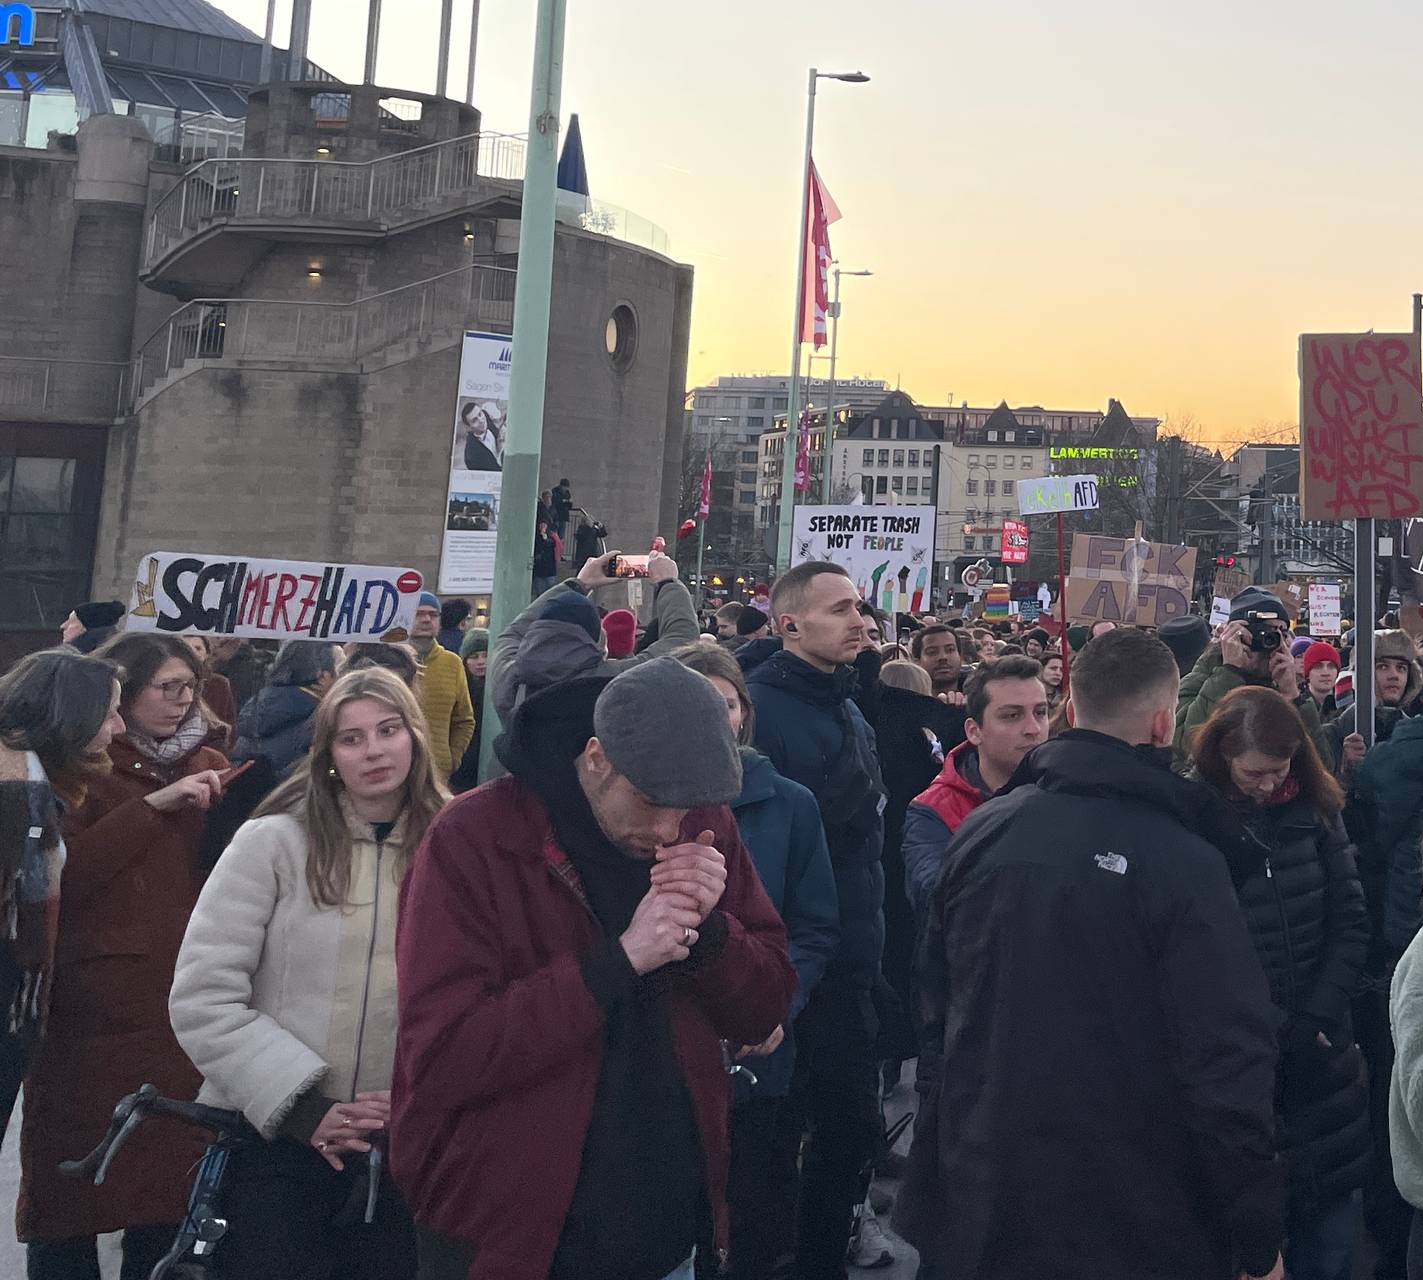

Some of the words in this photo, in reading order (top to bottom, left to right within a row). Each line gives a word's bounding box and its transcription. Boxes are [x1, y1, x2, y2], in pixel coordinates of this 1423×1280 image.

[1325, 480, 1421, 517] AFD
[808, 515, 878, 532] SEPARATE
[882, 516, 920, 534] TRASH
[827, 534, 853, 549] NOT
[863, 535, 904, 551] PEOPLE
[1086, 536, 1189, 590] FCK
[156, 558, 399, 637] SCHMERZHAFD
[1081, 581, 1188, 626] AFD
